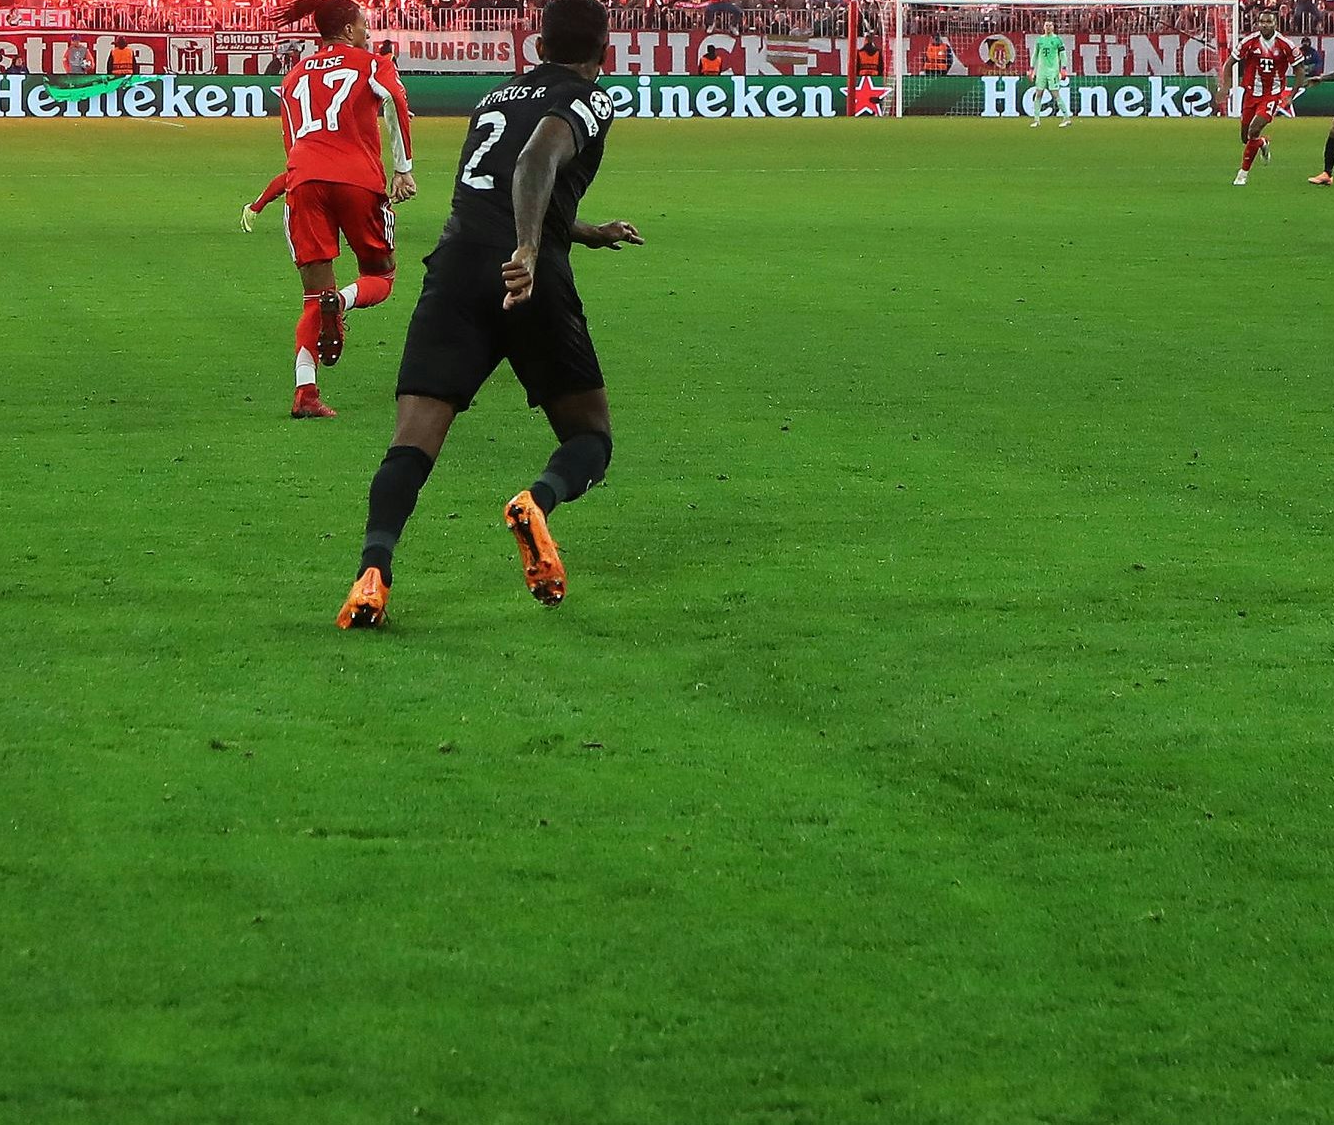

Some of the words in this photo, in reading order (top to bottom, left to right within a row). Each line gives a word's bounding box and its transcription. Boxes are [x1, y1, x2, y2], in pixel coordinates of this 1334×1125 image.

[216, 34, 260, 44] Sektion
[304, 56, 345, 70] OLISE
[292, 68, 359, 139] 17
[532, 86, 547, 99] R.
[601, 75, 837, 118] eineken
[461, 110, 507, 190] 2
